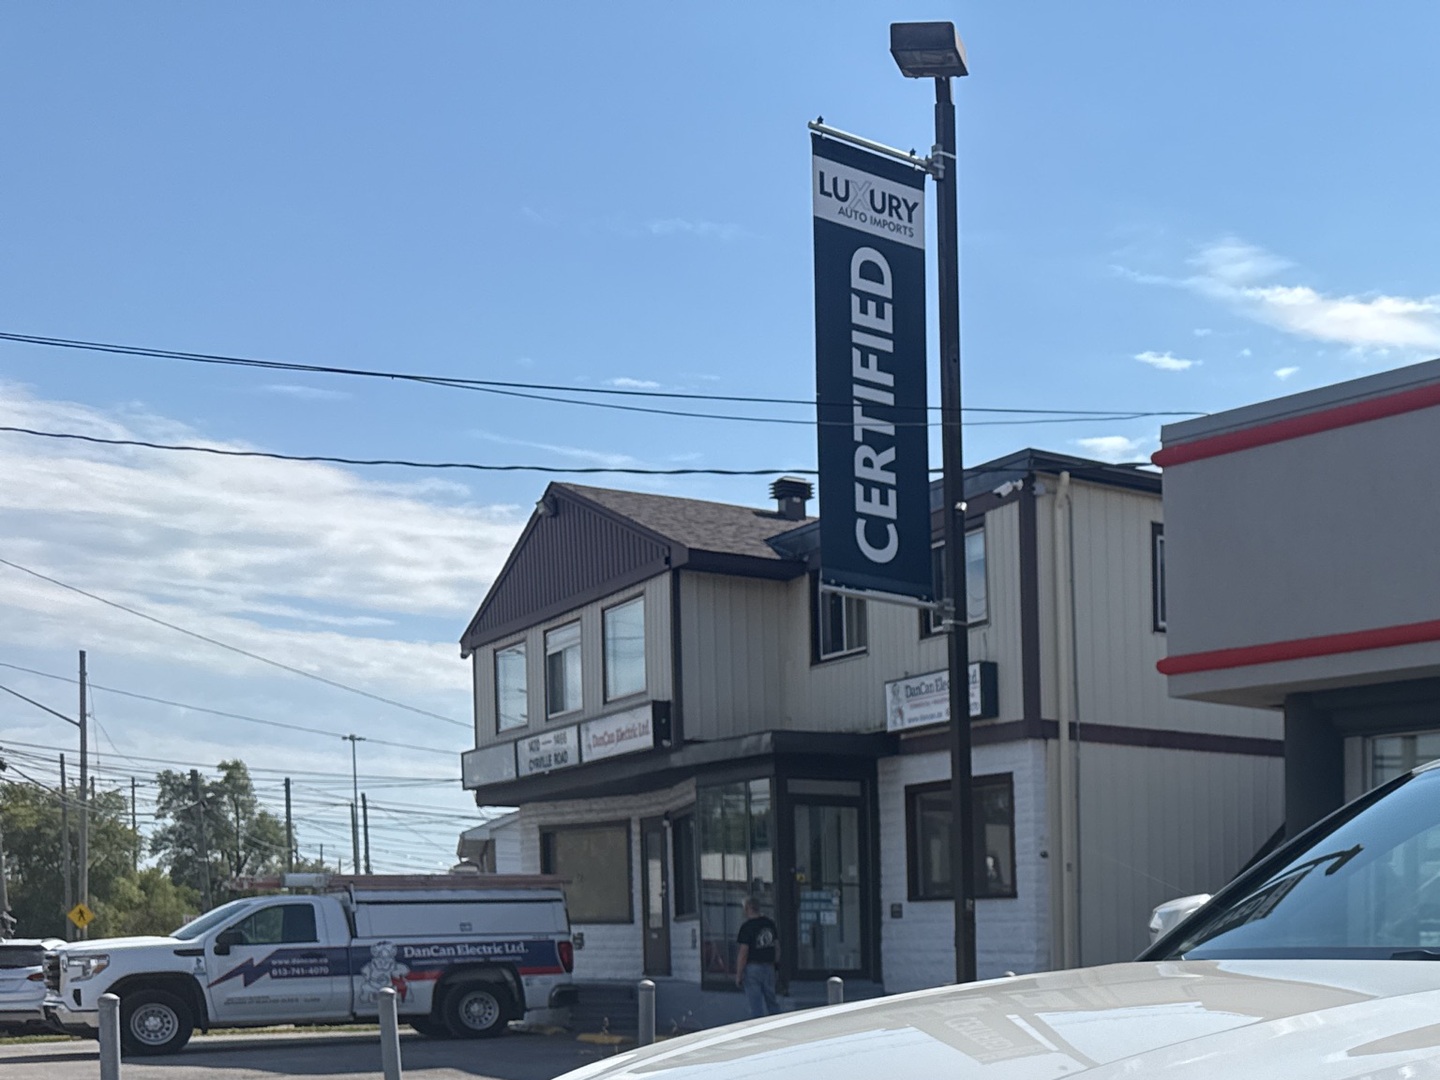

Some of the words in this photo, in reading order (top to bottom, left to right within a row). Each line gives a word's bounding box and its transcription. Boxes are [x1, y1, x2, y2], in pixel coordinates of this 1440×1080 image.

[819, 170, 920, 224] LUXURY
[838, 206, 868, 223] AUTO
[870, 216, 914, 238] IMPORTS
[850, 246, 899, 564] CERTIFIED
[403, 943, 456, 958] DanCan
[457, 942, 502, 956] Electric
[504, 941, 529, 954] Ltd.
